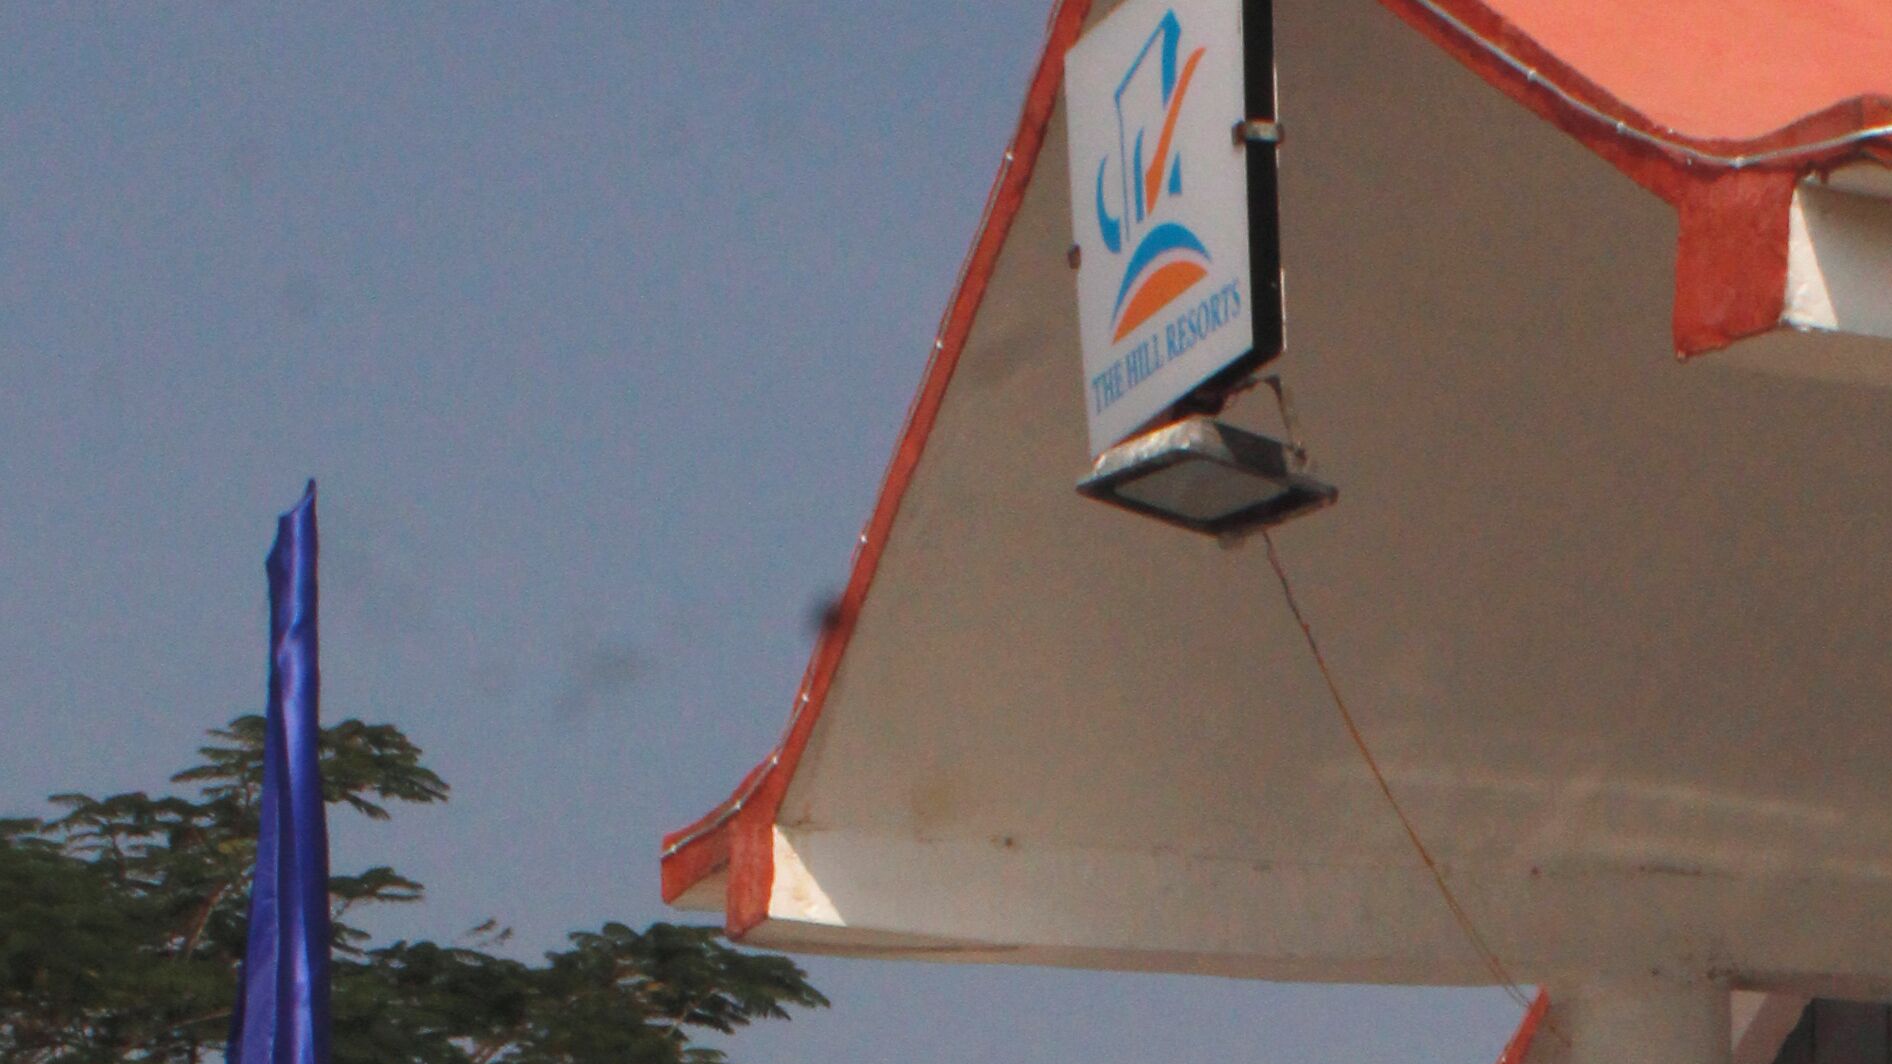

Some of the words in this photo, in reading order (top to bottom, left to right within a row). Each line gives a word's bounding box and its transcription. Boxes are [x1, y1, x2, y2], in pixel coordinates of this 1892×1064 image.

[1091, 359, 1123, 414] THE
[1125, 333, 1164, 389] HILL
[1165, 277, 1241, 362] RESORTS
